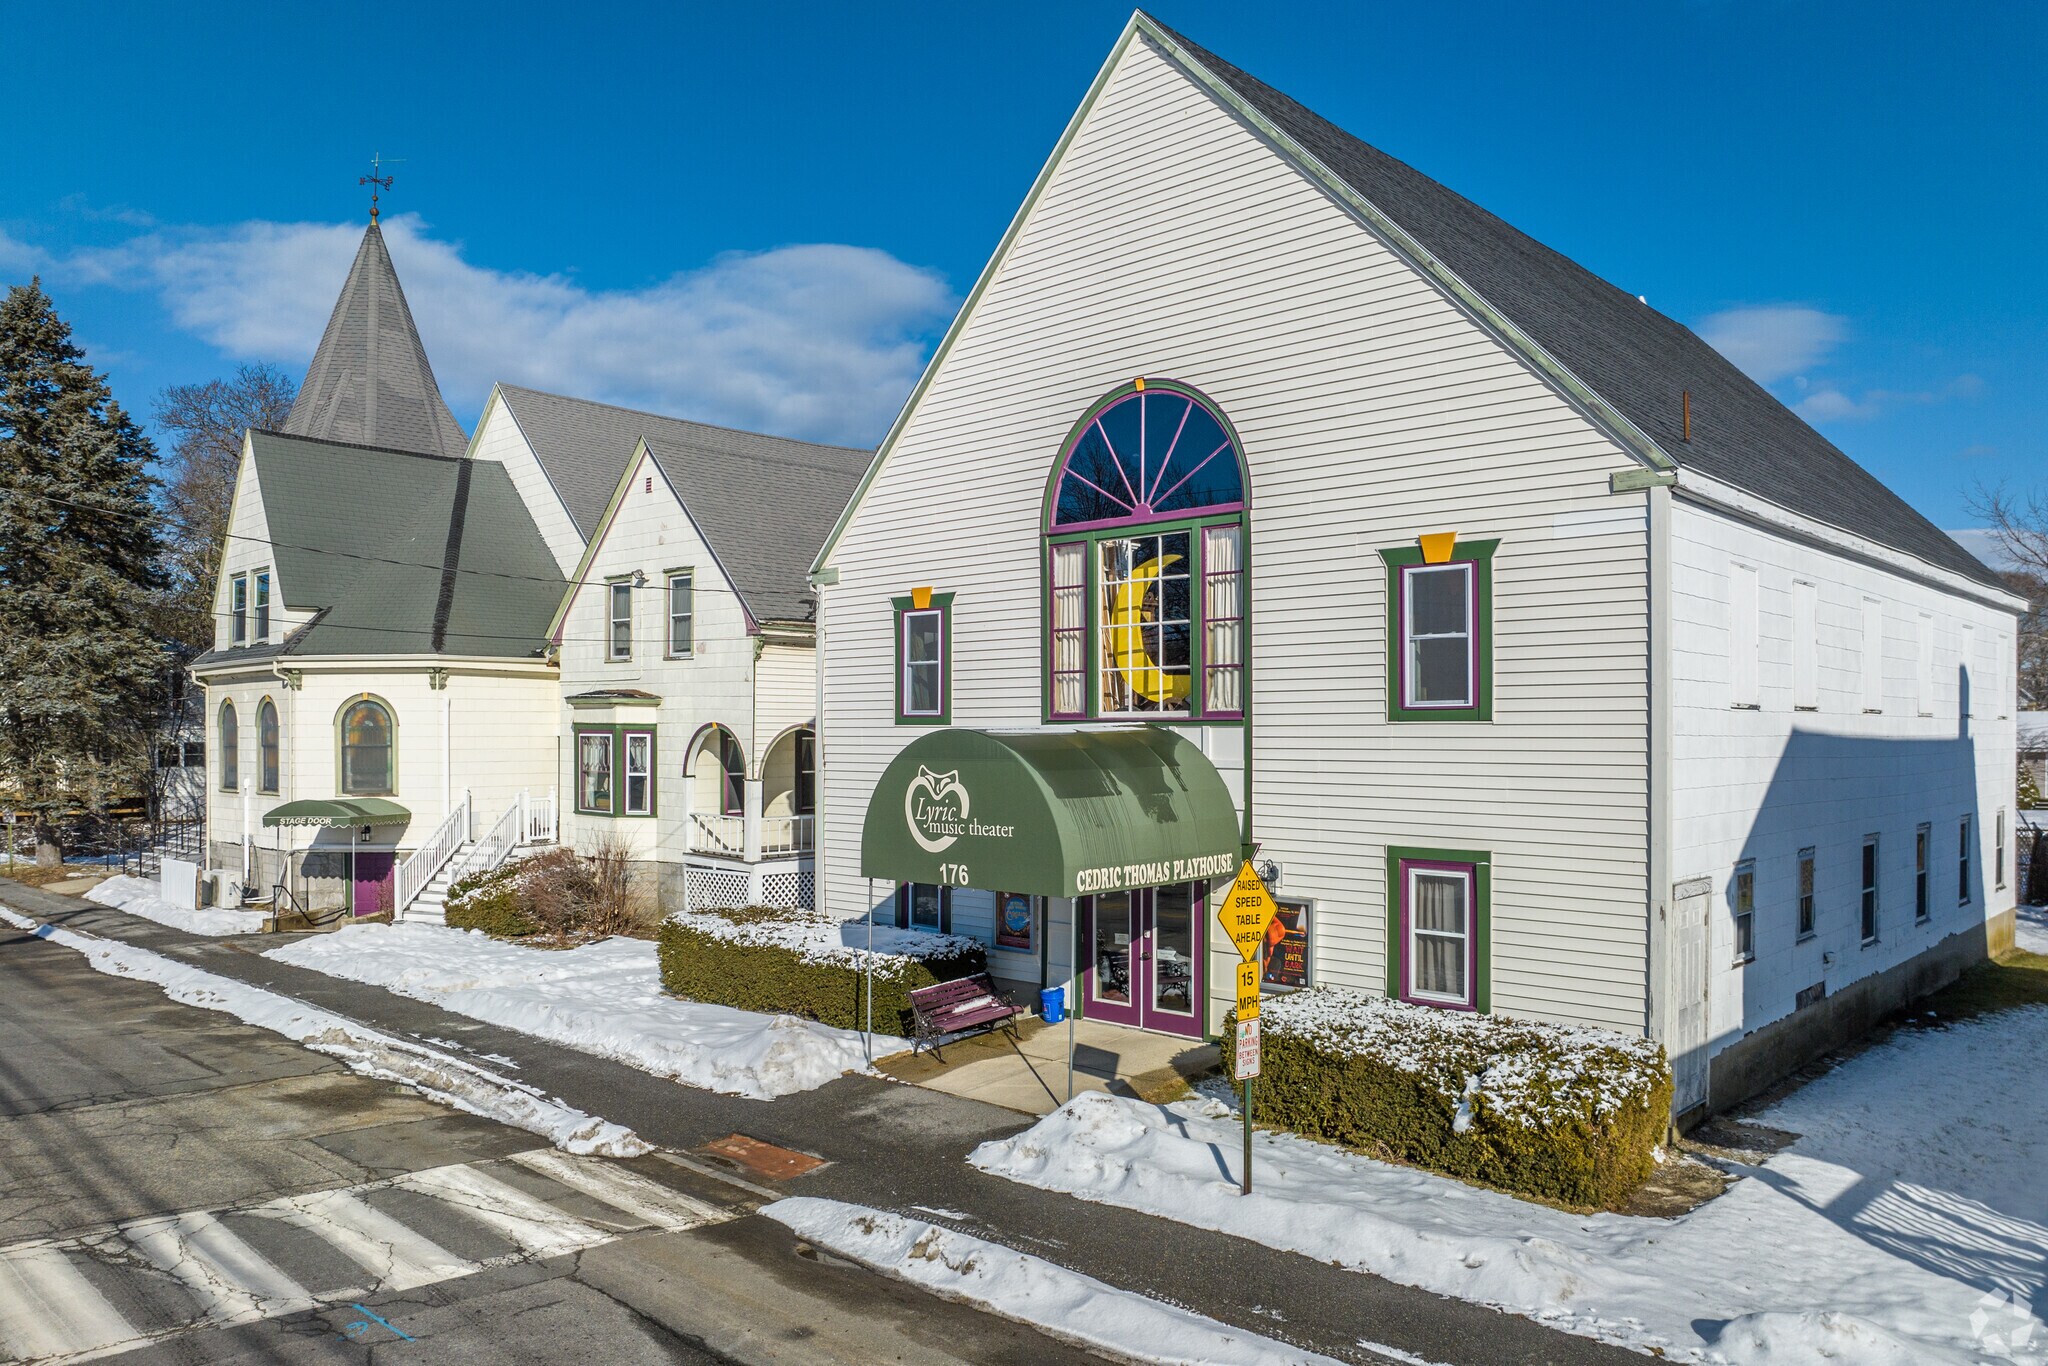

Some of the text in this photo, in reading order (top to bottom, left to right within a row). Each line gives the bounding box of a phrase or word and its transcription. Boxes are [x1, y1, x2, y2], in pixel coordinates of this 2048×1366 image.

[915, 797, 957, 828] Lyric
[929, 818, 1014, 838] music theater
[939, 863, 969, 886] 176
[1077, 853, 1233, 892] CEDRIC THOMAS PLAYHOUSE
[1237, 880, 1260, 891] RAISED
[1235, 896, 1262, 908] SPEED
[1236, 914, 1261, 925] TABLE
[1236, 931, 1261, 943] AHEAD
[1284, 953, 1303, 962] UNTIL
[1284, 960, 1303, 969] DARK
[1241, 972, 1254, 986] 15
[1239, 995, 1258, 1011] MPH
[1244, 1024, 1253, 1036] NO
[1239, 1036, 1258, 1047] PARKING
[1238, 1049, 1259, 1060] BETWEEN
[1242, 1058, 1255, 1067] SIGNS
